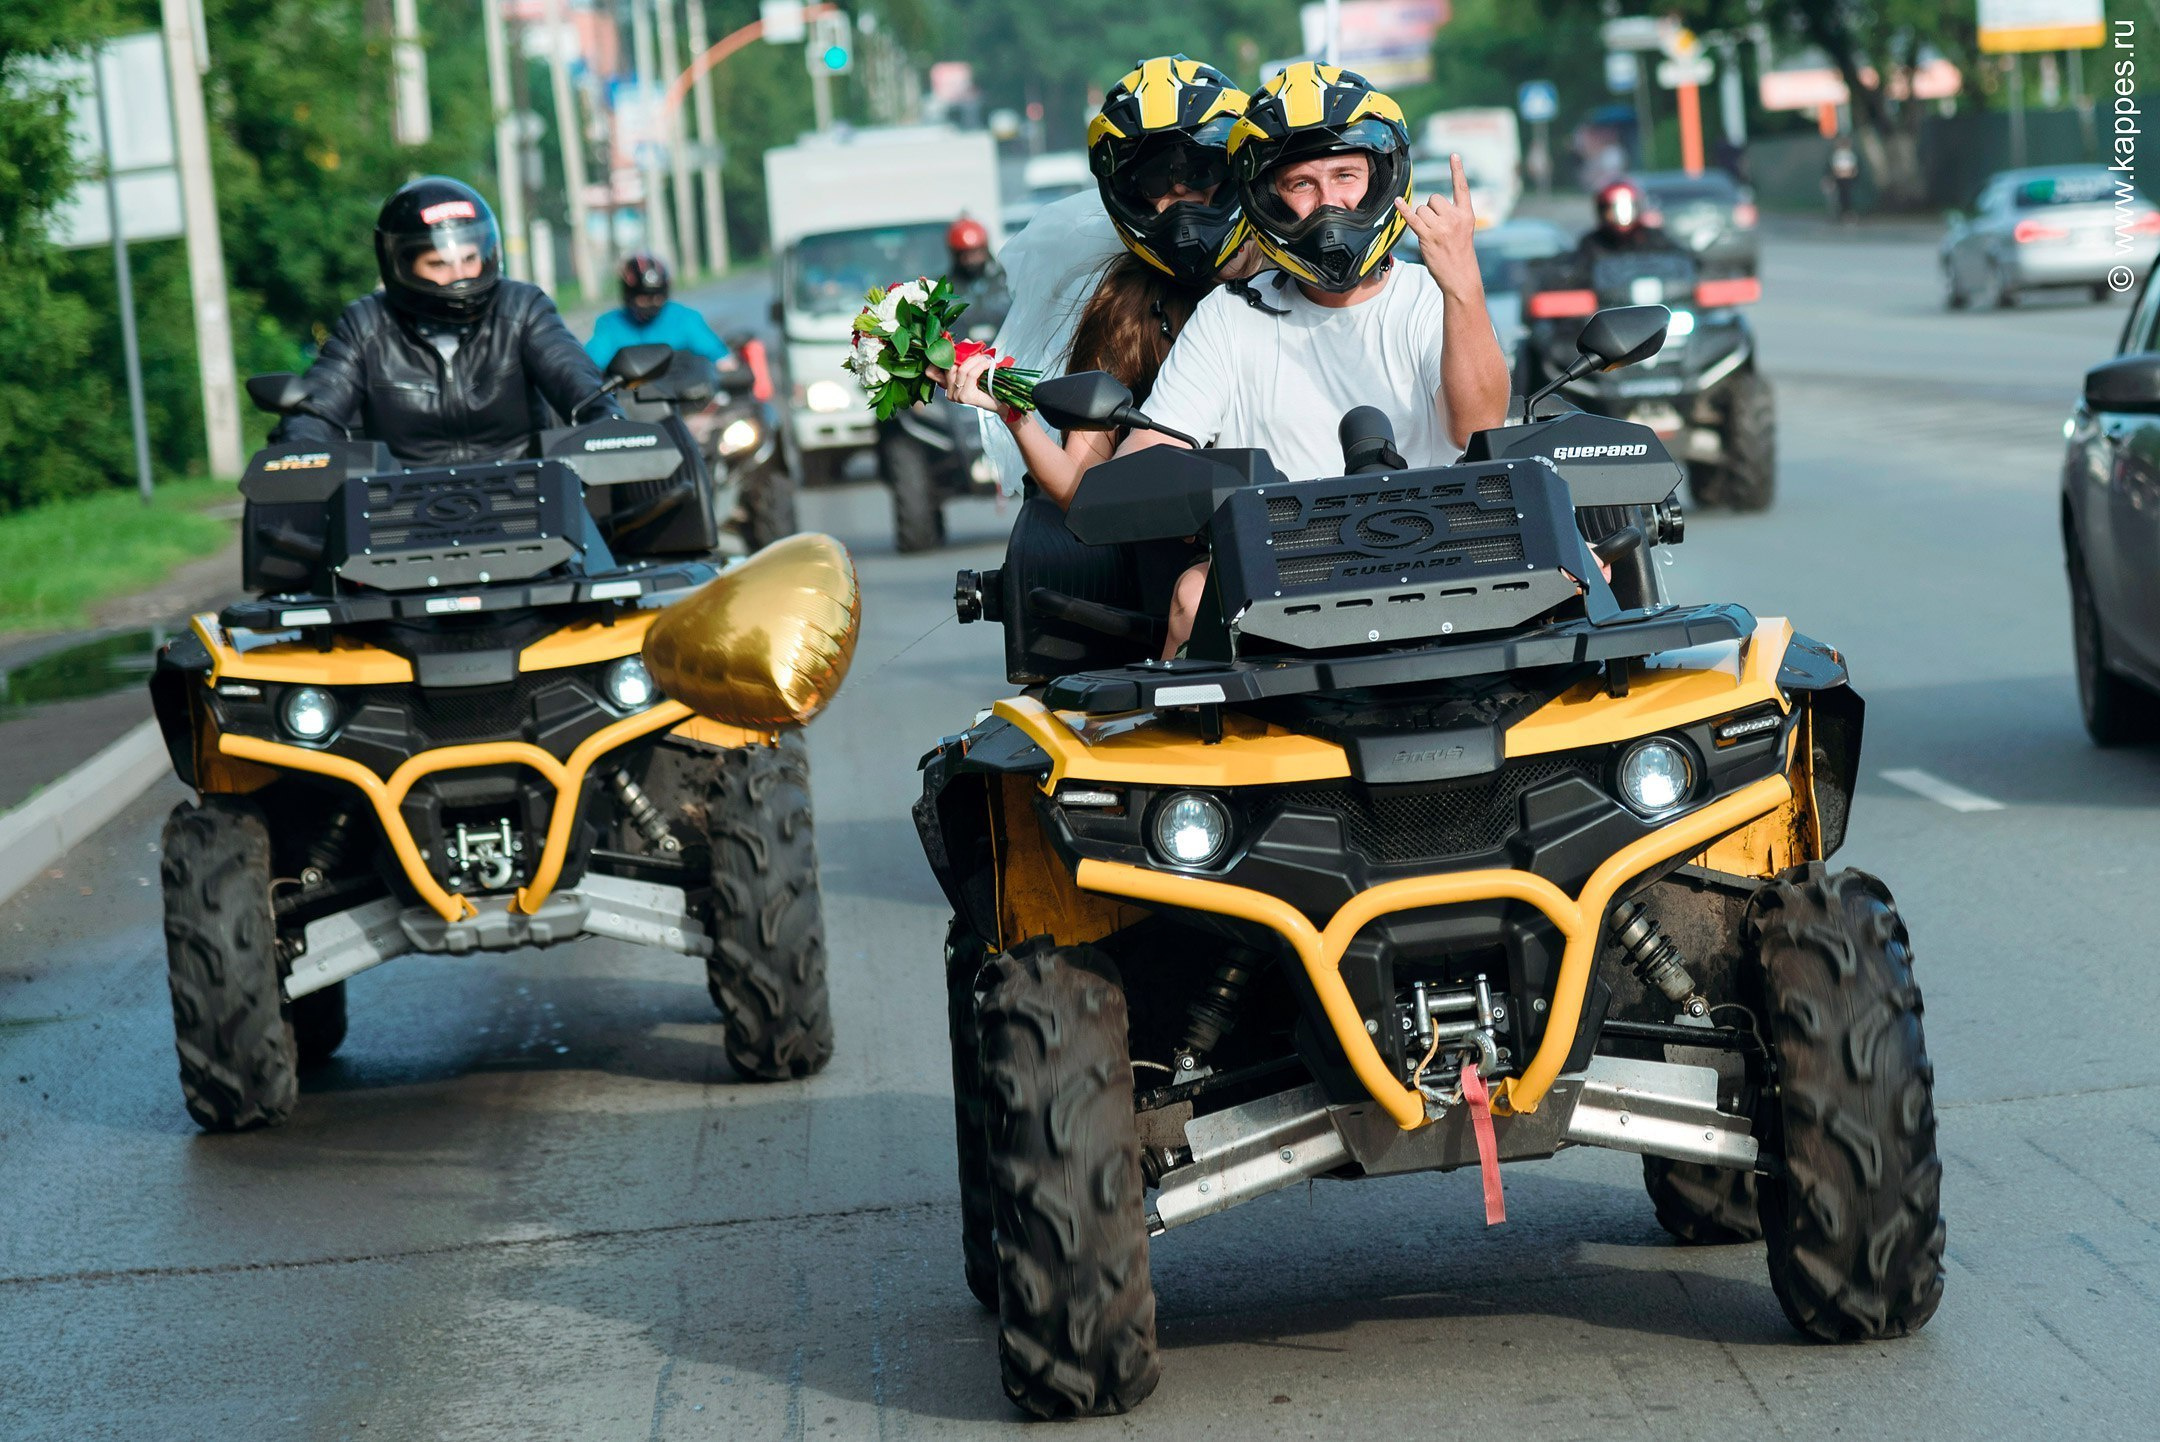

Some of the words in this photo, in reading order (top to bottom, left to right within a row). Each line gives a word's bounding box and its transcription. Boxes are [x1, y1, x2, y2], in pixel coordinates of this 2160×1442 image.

[1553, 444, 1648, 460] GUEPARD
[1312, 482, 1466, 511] STELS
[1342, 556, 1462, 577] GUEPARD
